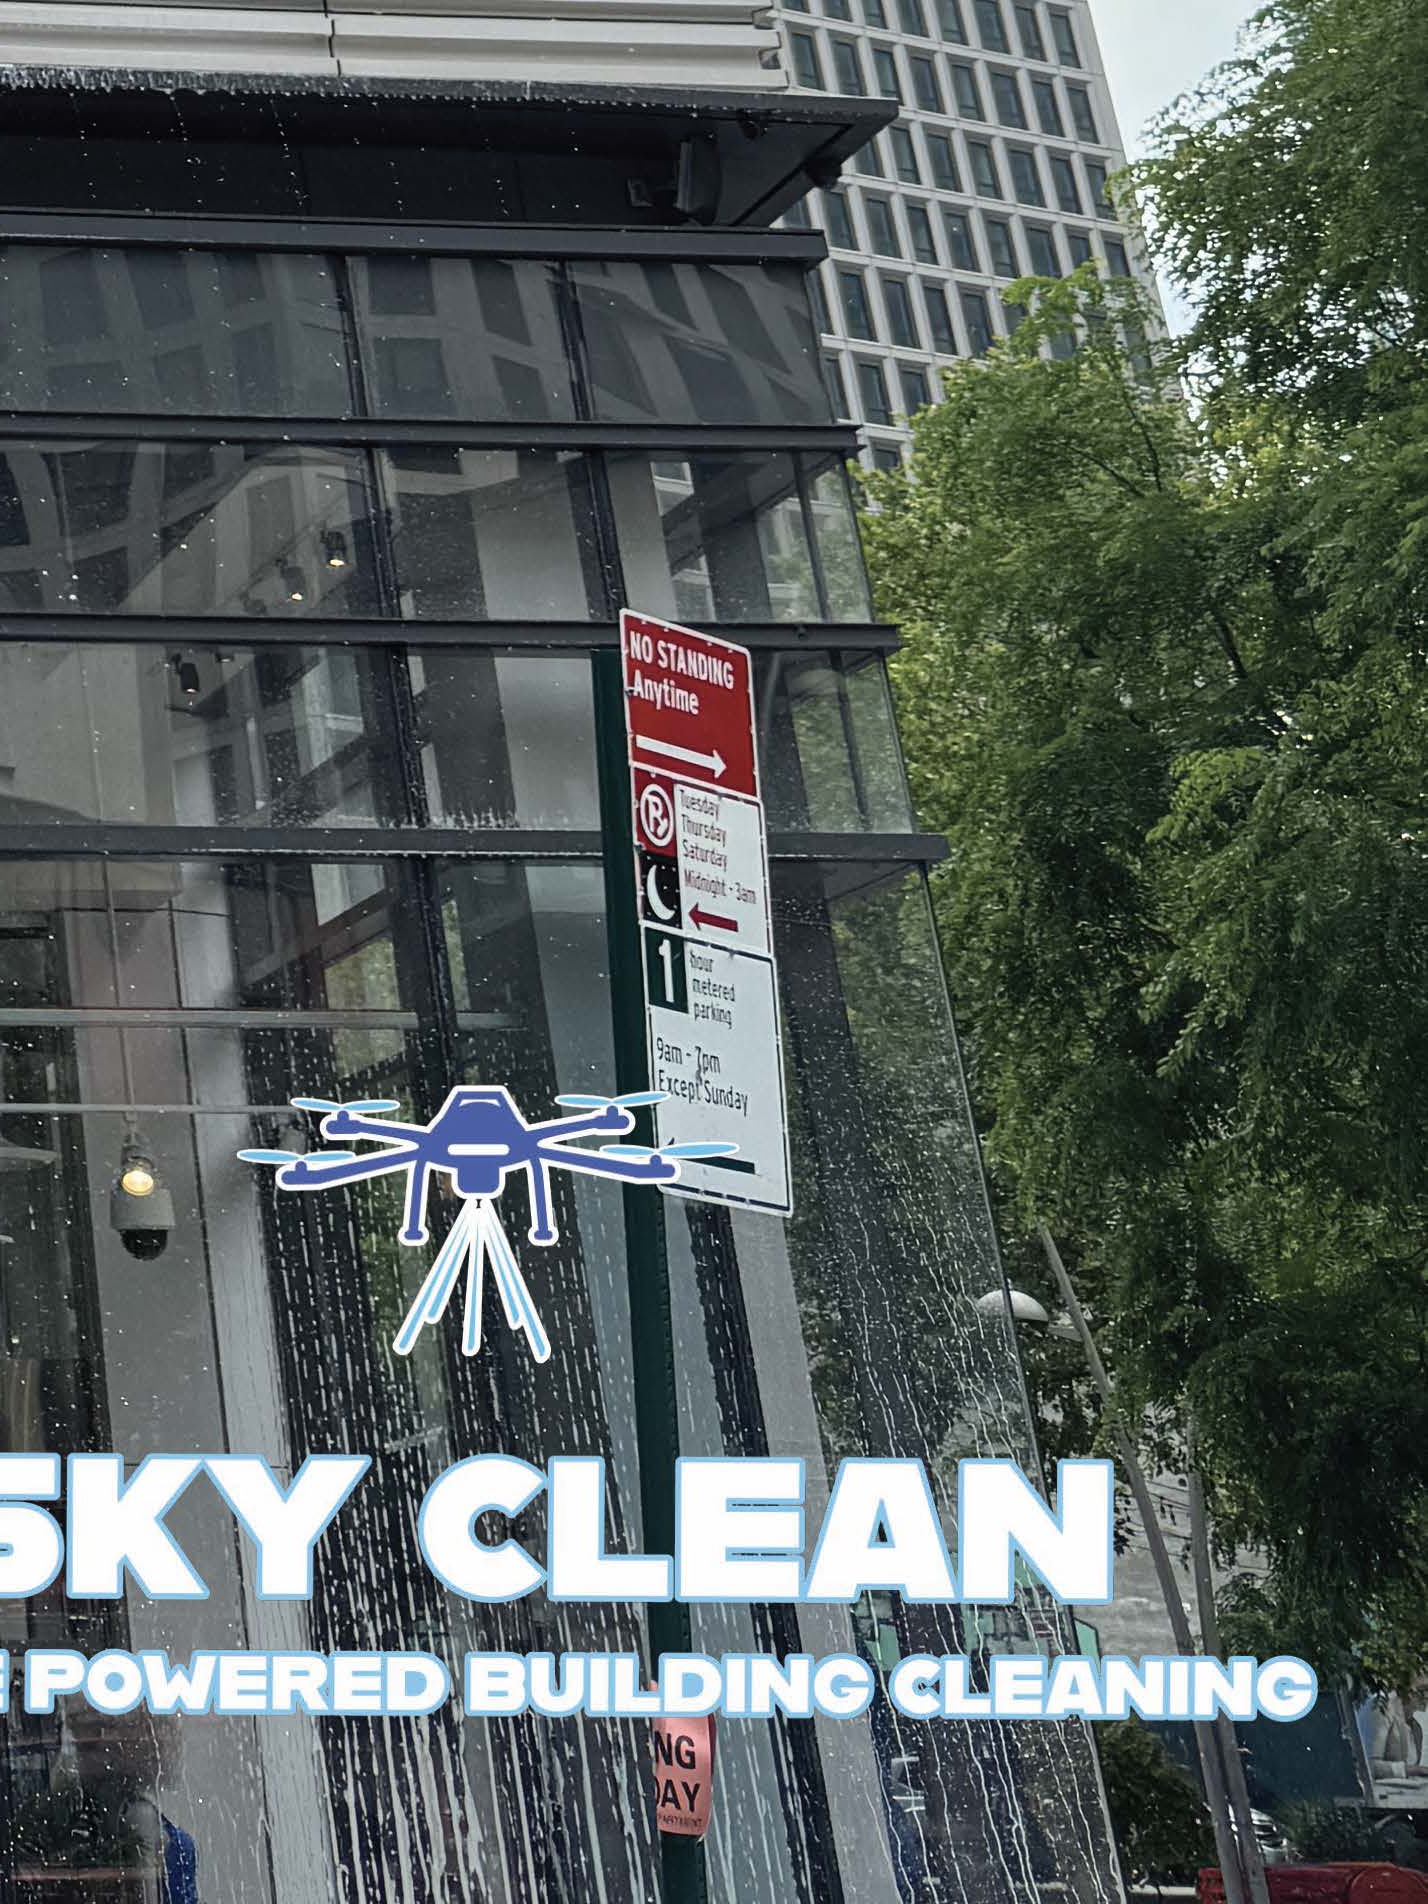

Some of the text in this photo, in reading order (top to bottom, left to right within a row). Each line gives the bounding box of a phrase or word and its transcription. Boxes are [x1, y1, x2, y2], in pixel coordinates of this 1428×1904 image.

[629, 630, 735, 690] NO STANDING
[633, 669, 700, 715] Anytime
[679, 789, 720, 821] Tuesday
[681, 813, 727, 848] Thursday
[682, 838, 728, 873] Saturday
[683, 868, 727, 898] Midnight
[658, 938, 675, 1004] 1
[689, 949, 715, 973] hour
[692, 977, 736, 1002] metered
[693, 1001, 733, 1030] parking
[656, 1036, 683, 1065] 9am
[694, 1046, 721, 1075] 7pm
[658, 1069, 749, 1117] Except Sunday
